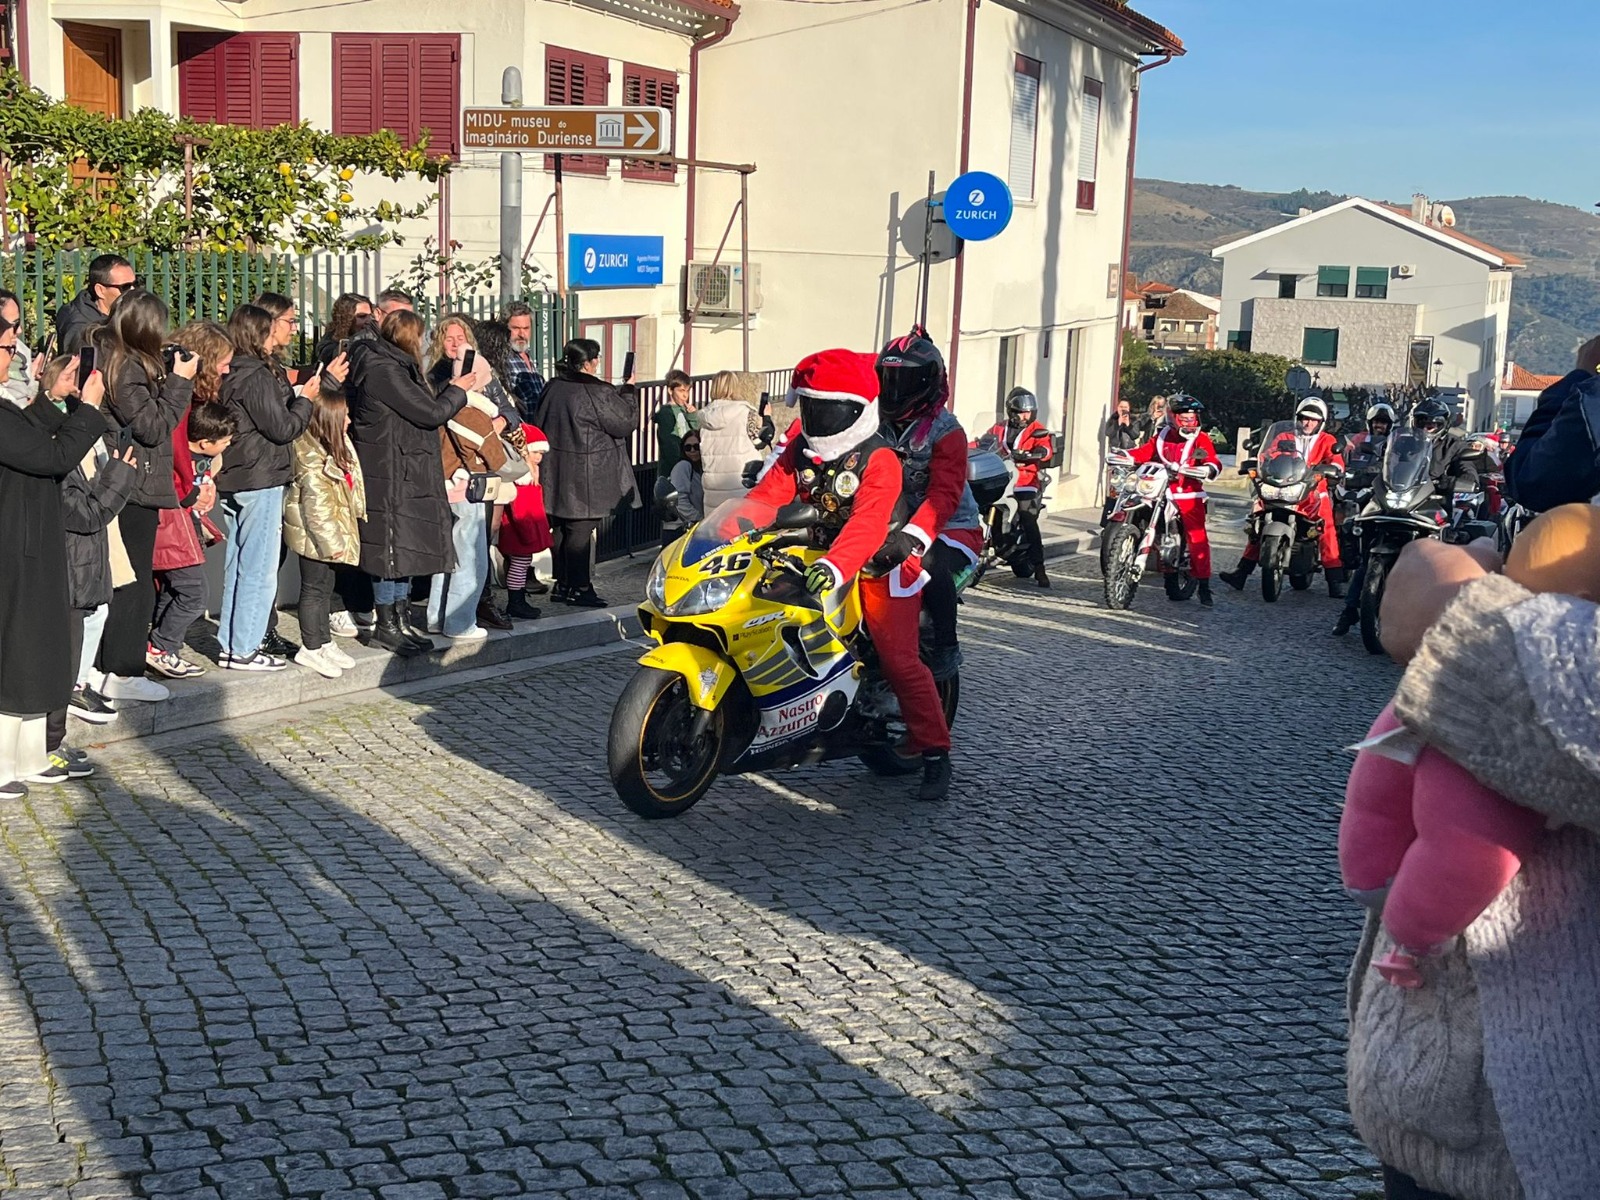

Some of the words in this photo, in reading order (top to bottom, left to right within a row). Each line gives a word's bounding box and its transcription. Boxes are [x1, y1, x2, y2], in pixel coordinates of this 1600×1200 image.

[466, 113, 506, 128] MIDU-
[511, 116, 551, 128] museu
[558, 120, 567, 129] do
[466, 130, 529, 146] imaginário
[537, 130, 593, 146] Duriense
[955, 210, 997, 220] ZURICH
[599, 253, 629, 268] ZURICH
[699, 551, 752, 575] 46
[778, 693, 823, 723] Nastro
[757, 711, 817, 738] Azzurro
[750, 739, 789, 755] HONDA
